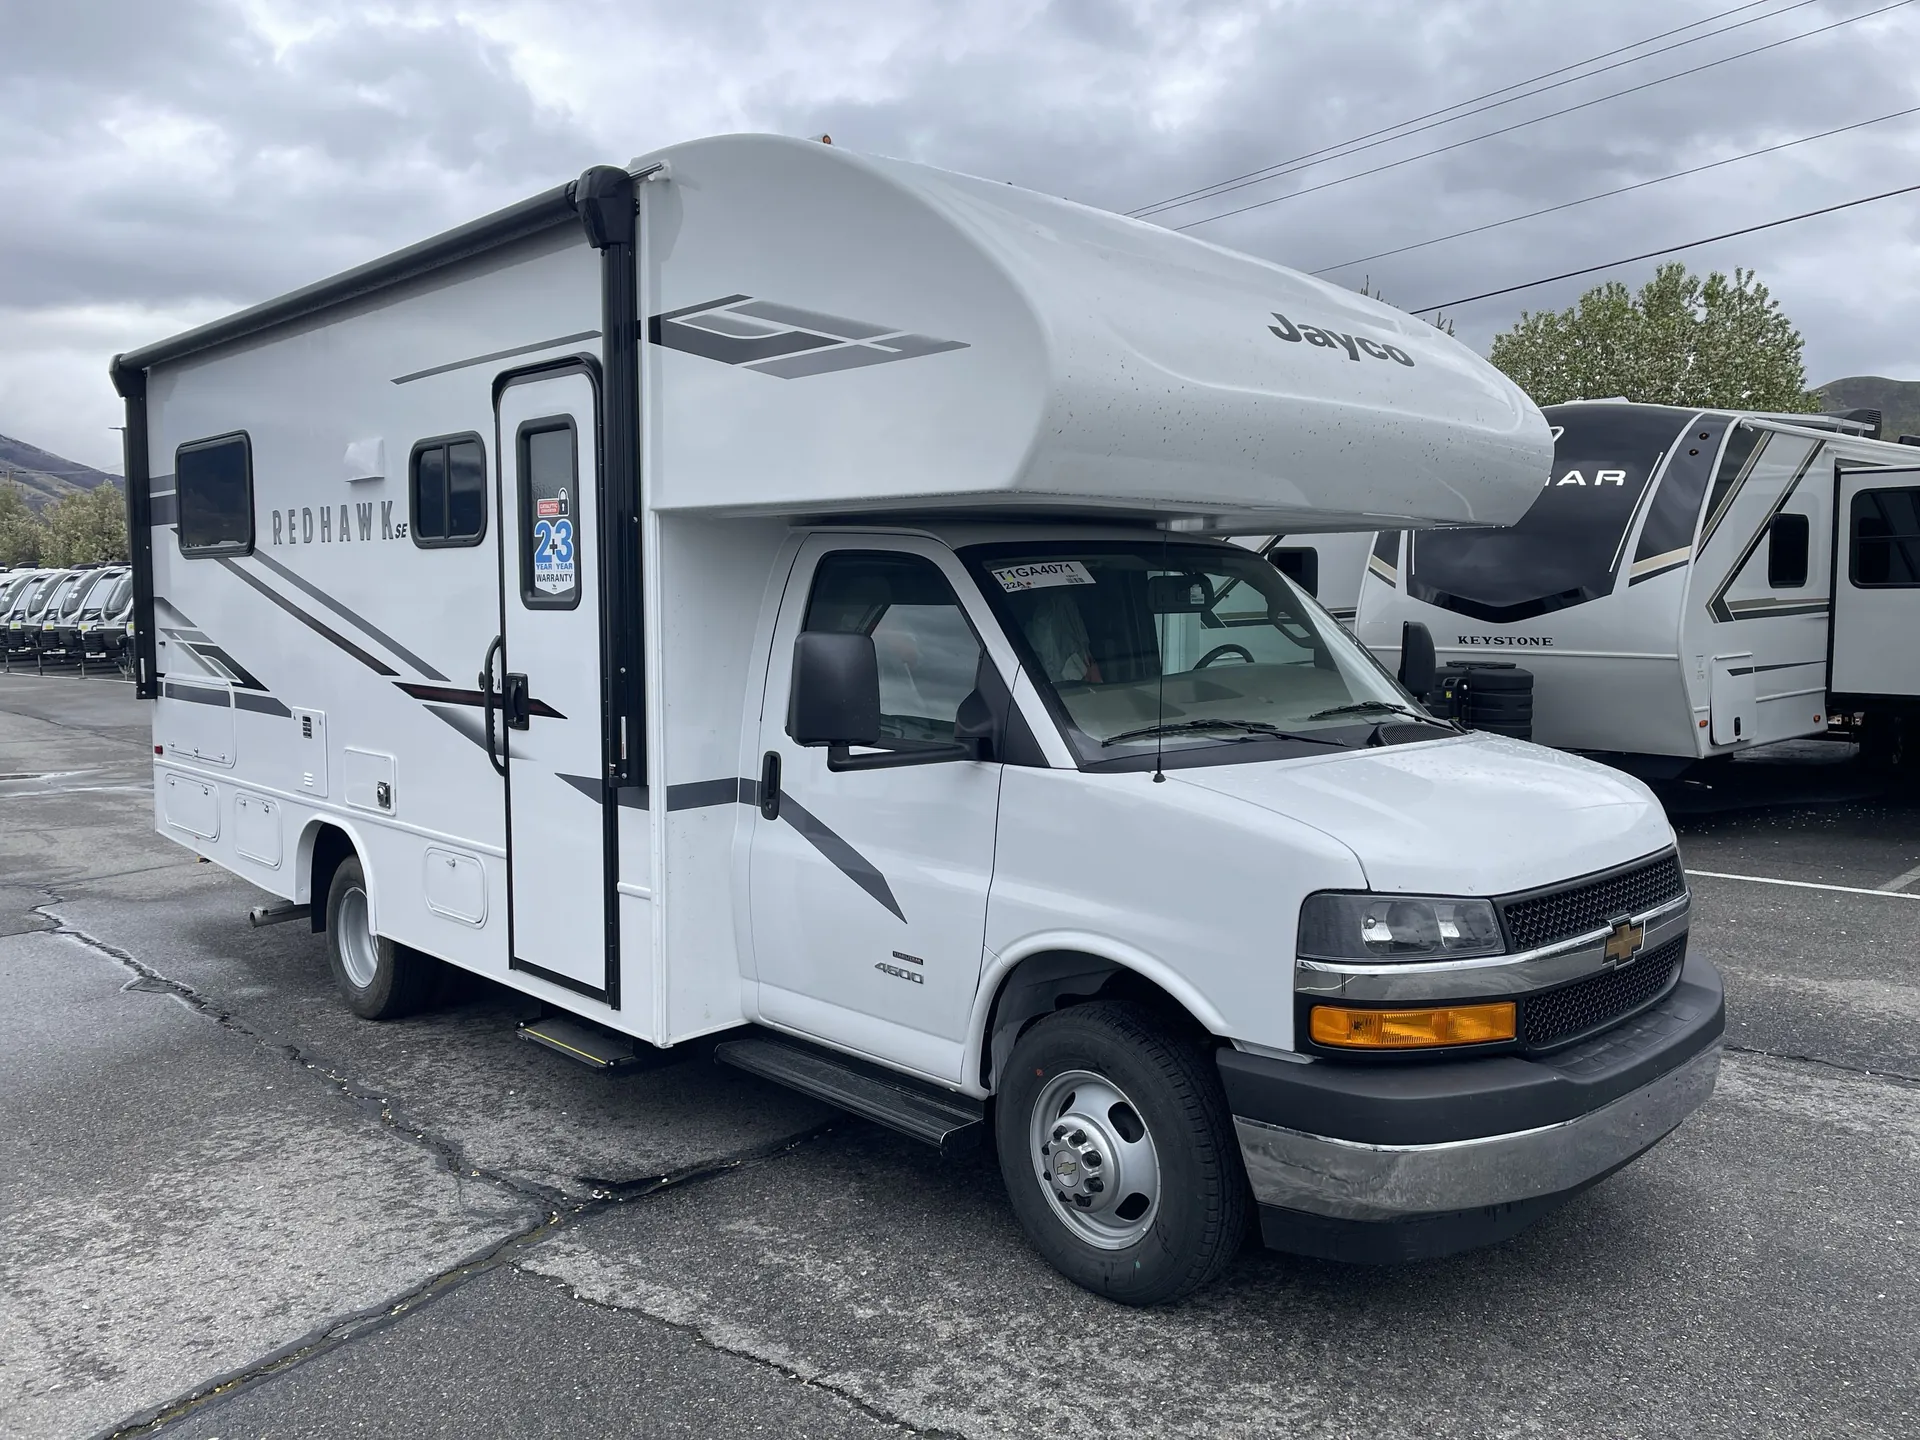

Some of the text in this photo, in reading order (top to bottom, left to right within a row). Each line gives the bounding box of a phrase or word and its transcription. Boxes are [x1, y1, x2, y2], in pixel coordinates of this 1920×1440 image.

[1267, 312, 1415, 367] Jayco
[272, 500, 408, 545] REDHAWK SE
[556, 562, 573, 570] YEAR
[994, 563, 1075, 581] T1GA4071
[536, 573, 573, 583] WARRANTY
[1457, 635, 1554, 647] KEYSTONE
[874, 962, 925, 985] 4500
